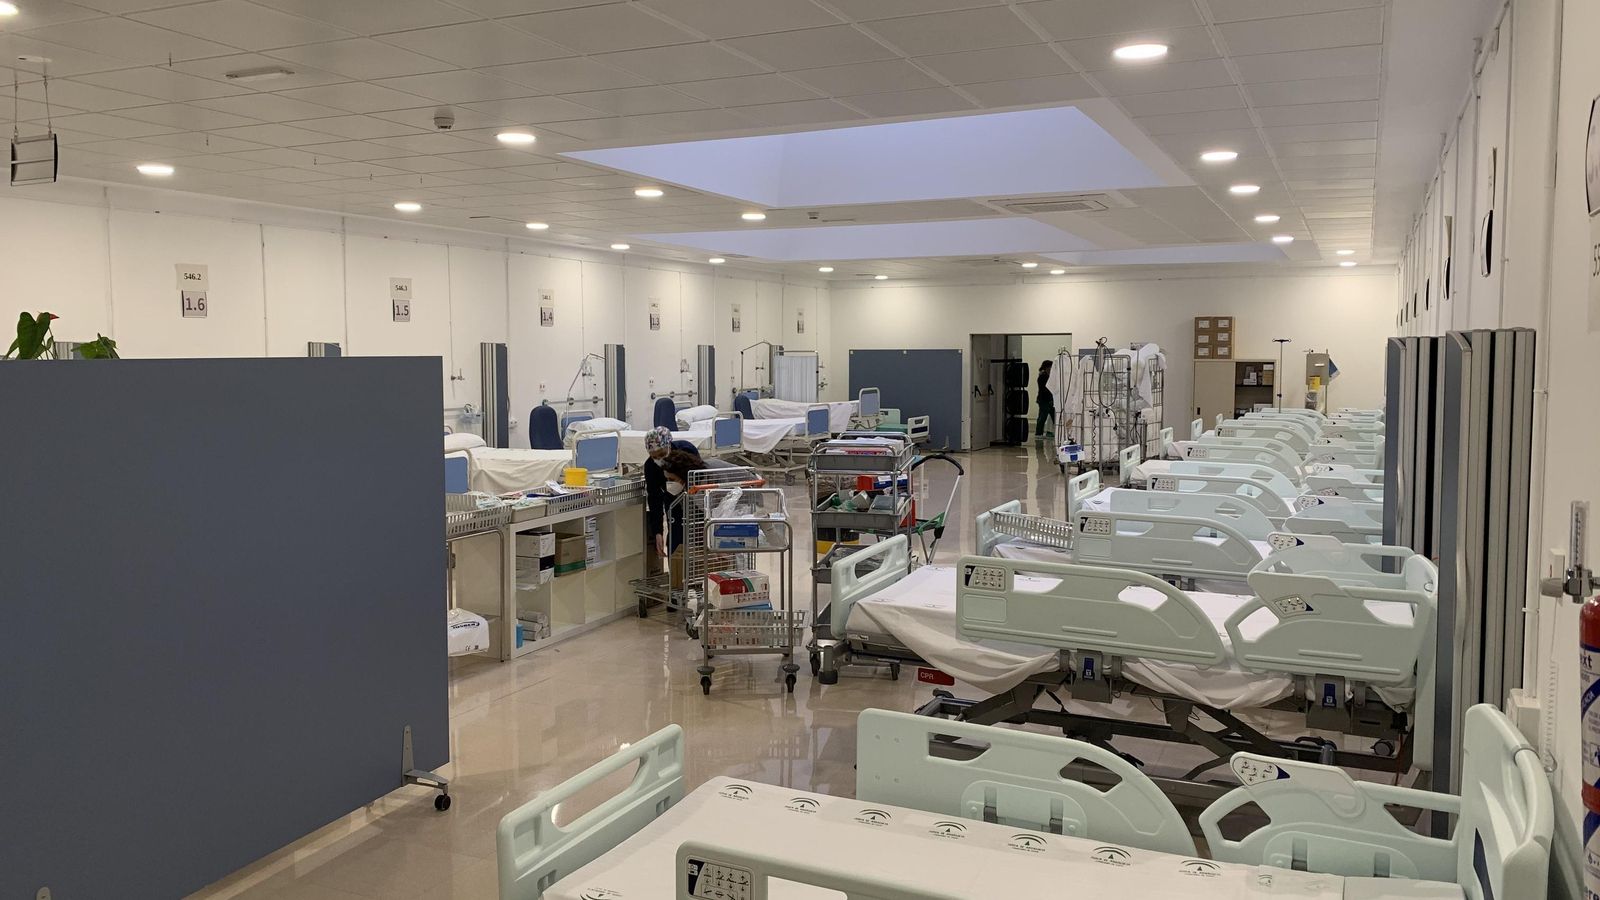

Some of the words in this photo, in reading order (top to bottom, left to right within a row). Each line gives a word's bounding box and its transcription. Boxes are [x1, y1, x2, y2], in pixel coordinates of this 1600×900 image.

[183, 272, 202, 281] 546.2
[185, 297, 205, 311] 1.6
[396, 304, 409, 319] 1.5
[543, 311, 553, 322] 1.4
[920, 671, 934, 680] CPR
